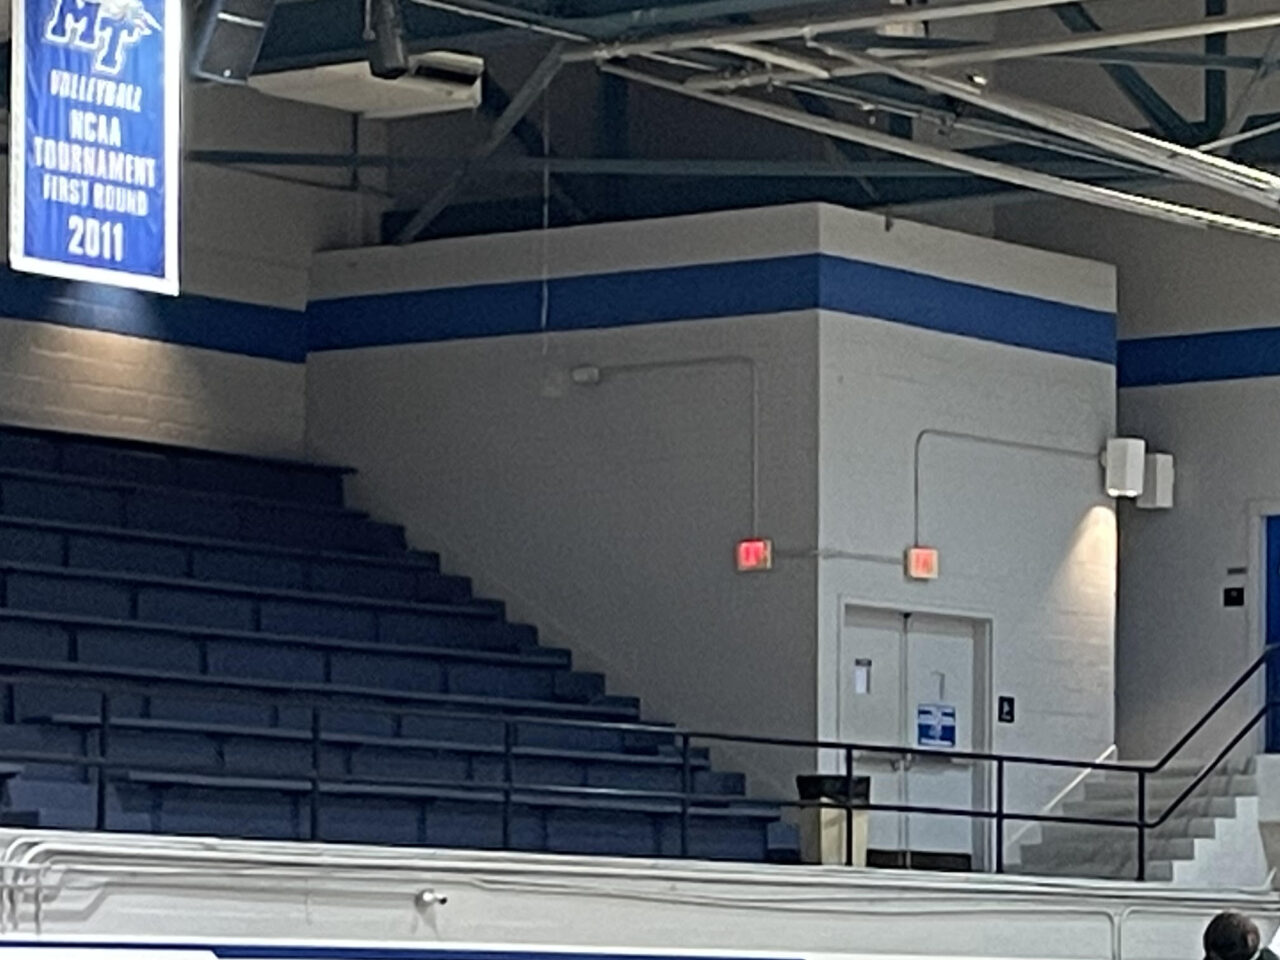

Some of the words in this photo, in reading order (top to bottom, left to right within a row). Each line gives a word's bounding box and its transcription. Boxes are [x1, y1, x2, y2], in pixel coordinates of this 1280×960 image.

[50, 69, 142, 113] VOLLEYBALL
[69, 109, 122, 148] NCAA
[33, 136, 156, 188] TOURNAMENT
[43, 174, 89, 206] FIRST
[93, 182, 149, 217] ROUND
[68, 215, 124, 262] 2011
